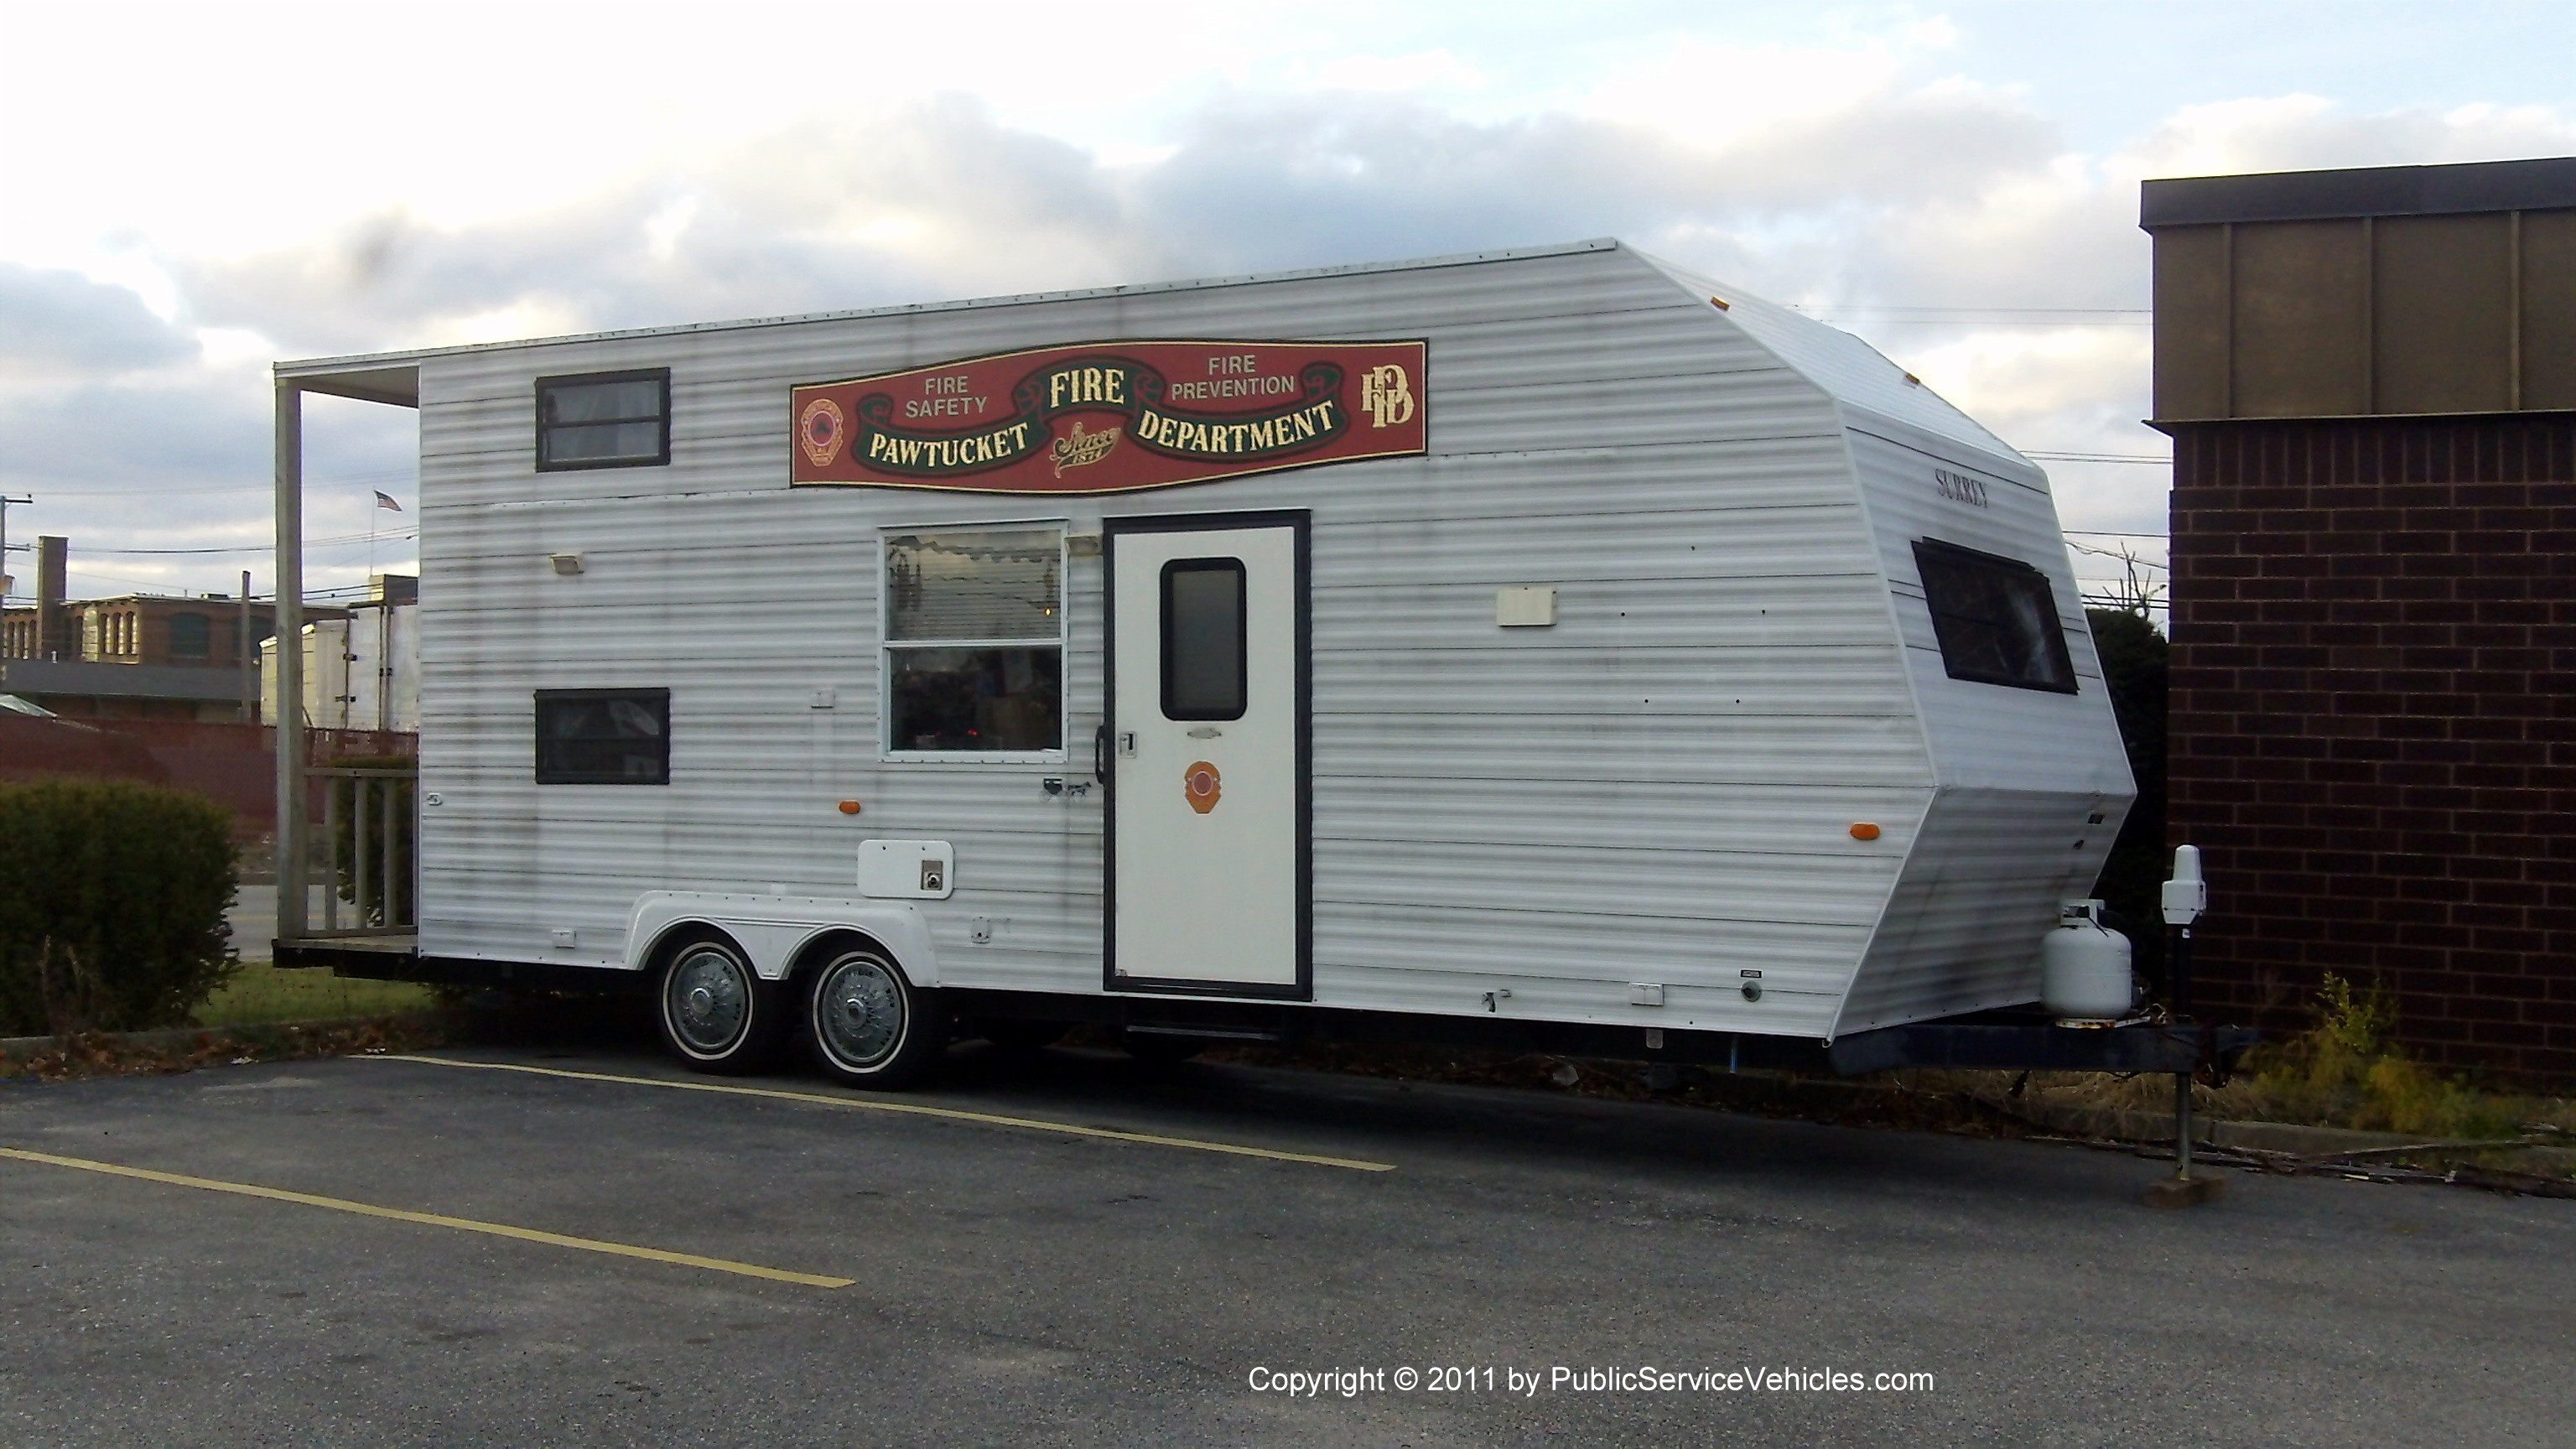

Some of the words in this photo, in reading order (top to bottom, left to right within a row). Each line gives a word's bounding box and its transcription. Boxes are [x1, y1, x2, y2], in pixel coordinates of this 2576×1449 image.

[1208, 355, 1256, 376] FIRE
[925, 377, 969, 395] FIRE
[1050, 367, 1125, 408] FIRE
[1171, 375, 1295, 401] PREVENTION
[906, 397, 987, 418] SAFETY
[1137, 400, 1334, 453] DEPARTMENT
[870, 422, 1028, 467] PAWTUCKET
[1935, 468, 1987, 509] SURREY
